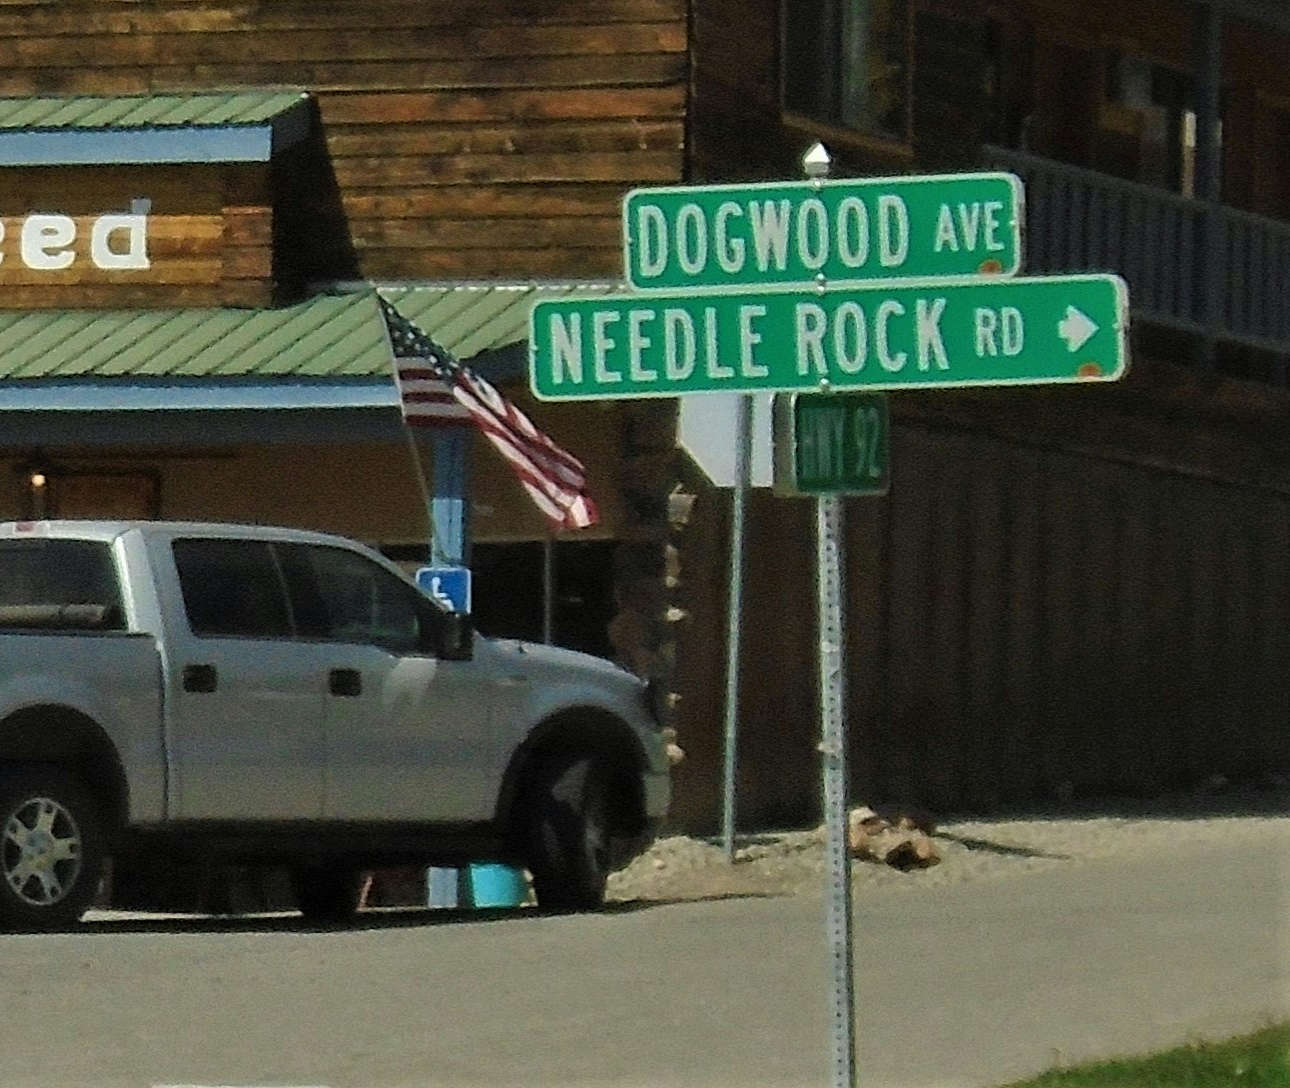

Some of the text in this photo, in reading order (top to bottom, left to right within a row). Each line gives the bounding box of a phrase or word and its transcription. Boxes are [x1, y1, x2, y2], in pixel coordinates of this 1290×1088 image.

[637, 194, 1006, 278] DOGWOOD AVE
[549, 298, 1024, 385] NEEDLE ROCK RD
[853, 407, 882, 477] 92
